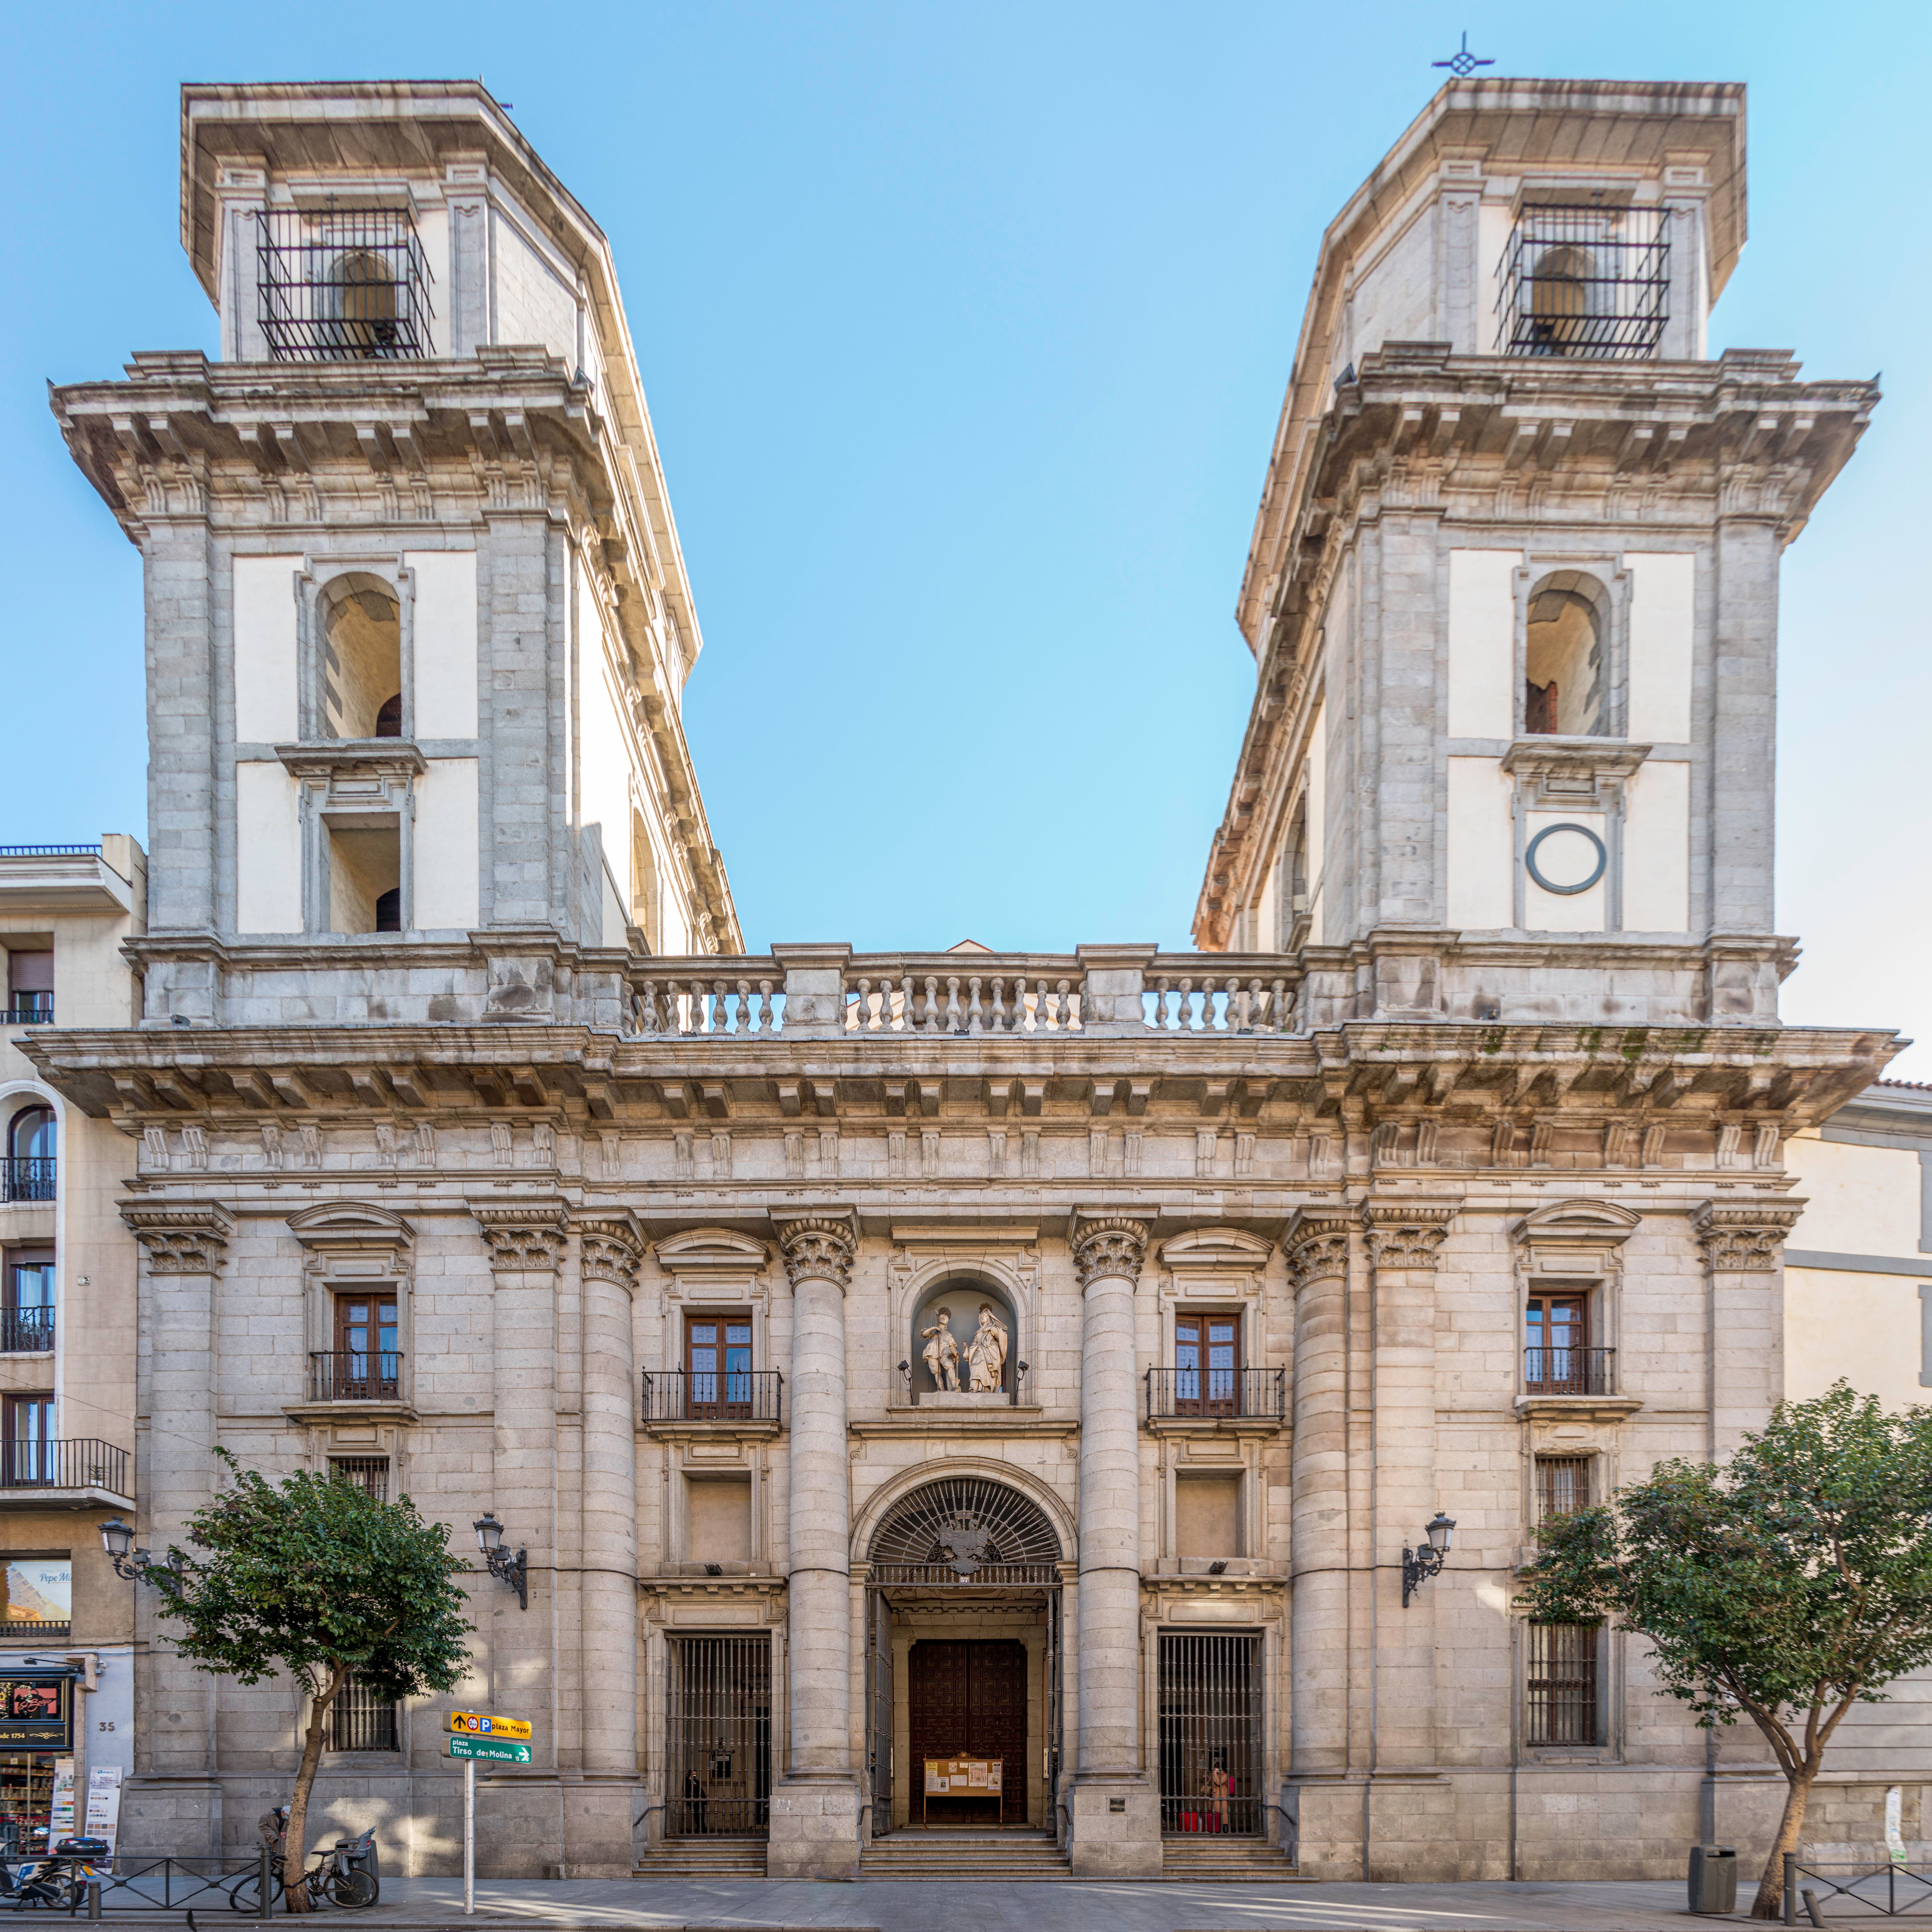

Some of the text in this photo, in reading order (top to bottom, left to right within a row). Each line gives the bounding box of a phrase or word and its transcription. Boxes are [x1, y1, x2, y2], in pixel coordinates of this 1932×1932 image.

[39, 1573, 58, 1584] Pepe
[99, 1722, 115, 1731] 35
[511, 1725, 529, 1733] Mayor
[452, 1746, 472, 1755] Tirso
[490, 1750, 512, 1759] Molina
